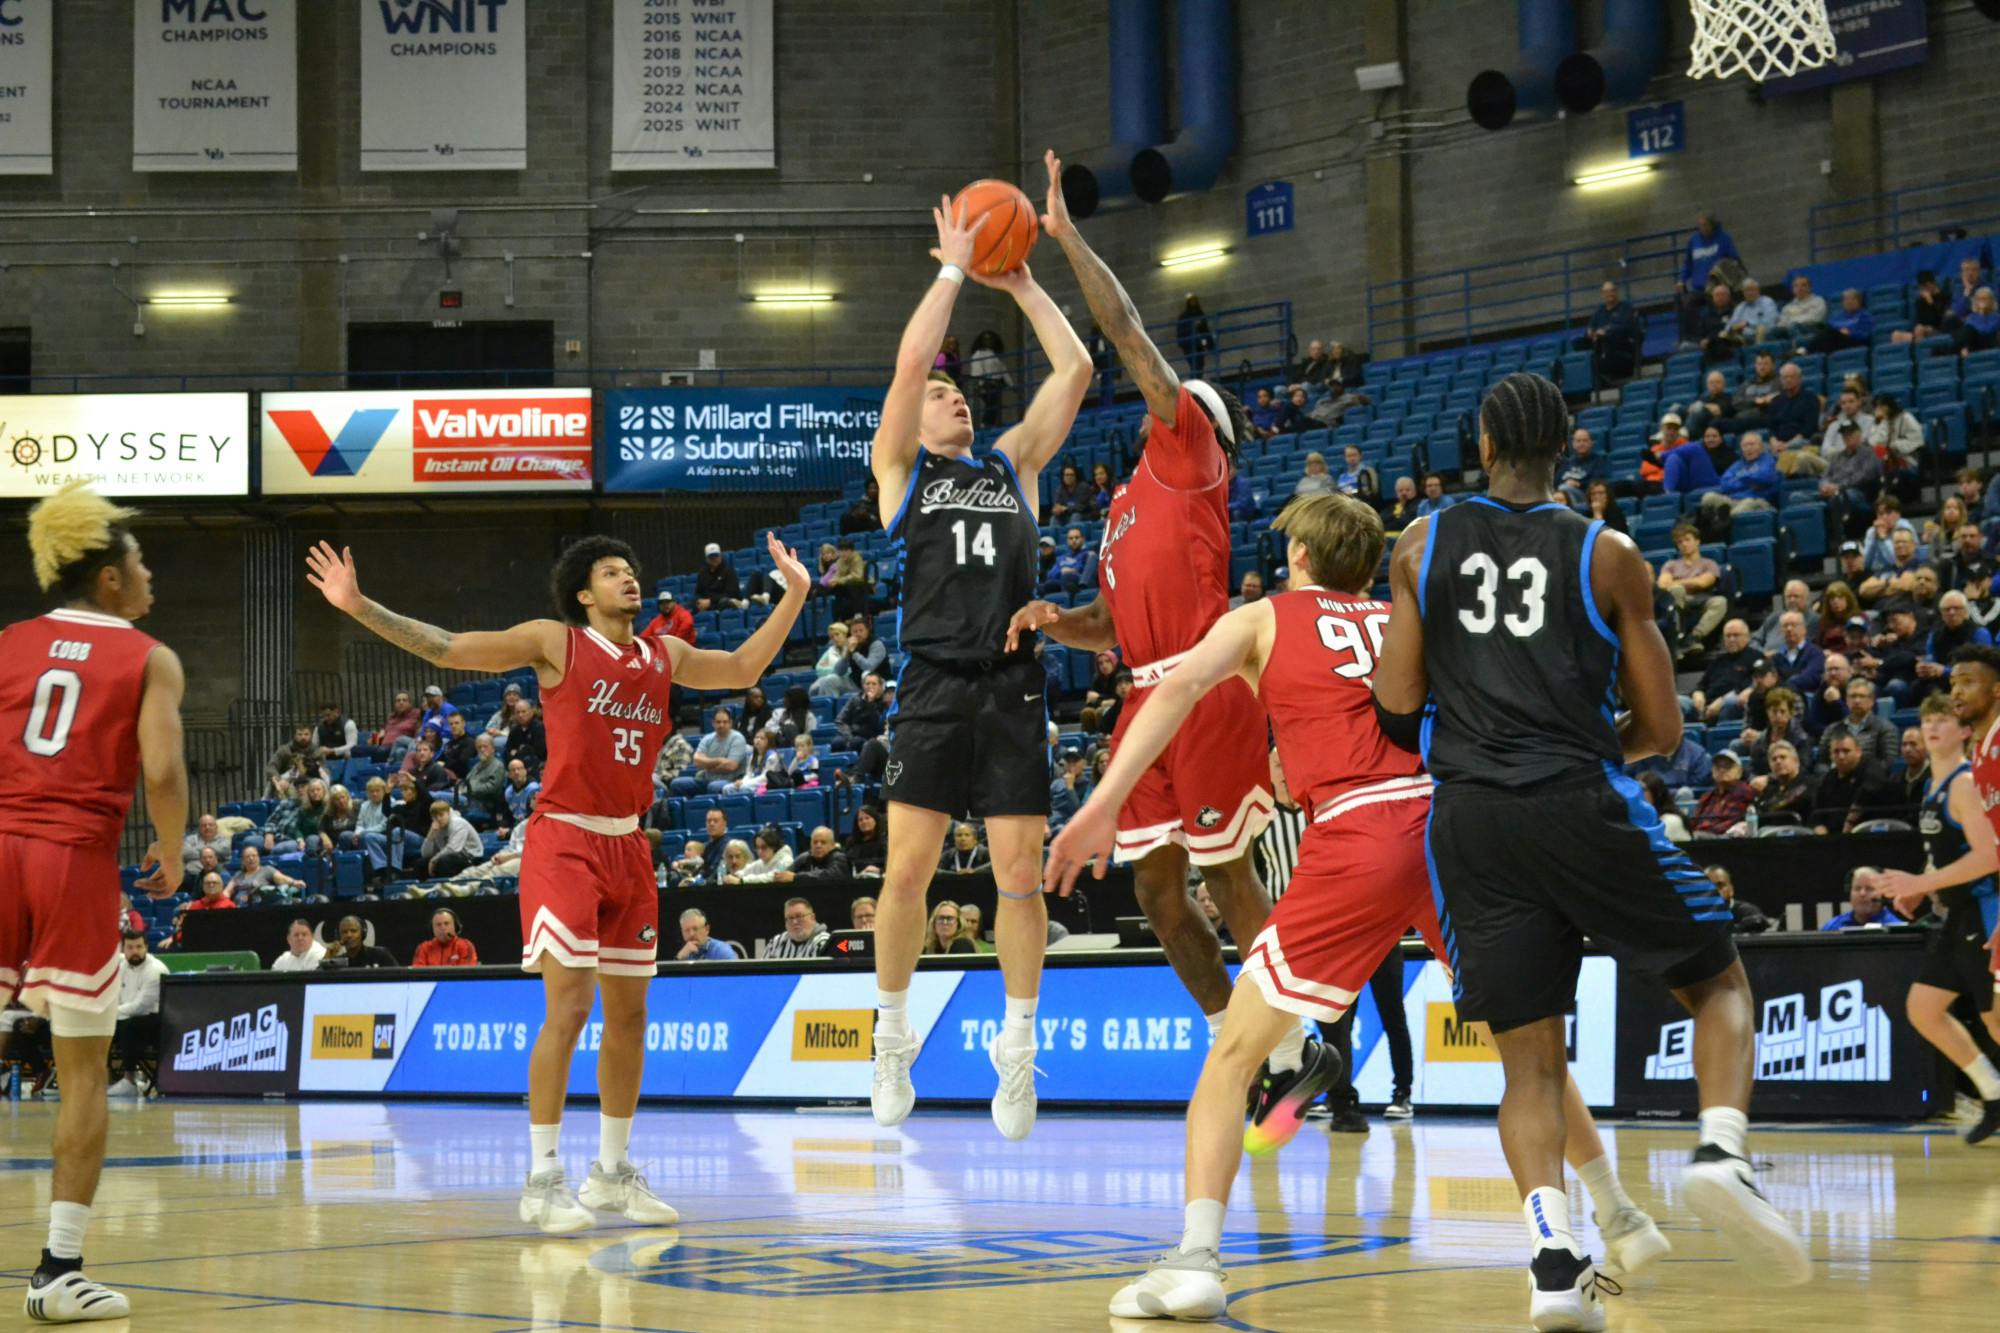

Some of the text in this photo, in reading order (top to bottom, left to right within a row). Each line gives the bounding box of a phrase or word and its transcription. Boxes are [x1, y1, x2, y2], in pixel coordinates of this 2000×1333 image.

[161, 0, 268, 23] MAC
[378, 0, 508, 34] WNIT
[643, 12, 737, 25] 2015 WNIT
[161, 27, 269, 43] CHAMPIONS
[643, 30, 743, 42] 2016 NCAA
[390, 42, 497, 56] CHAMPIONS
[643, 48, 743, 60] 2018 NCAA
[191, 79, 237, 91] NCAA
[643, 66, 743, 78] 2019 NCAA
[158, 96, 270, 109] TOURNAMENT
[643, 84, 743, 96] 2022 NCAA
[643, 102, 741, 114] 2024 WNIT
[643, 119, 741, 132] 2025 WNIT
[1639, 124, 1675, 152] 112
[1256, 205, 1285, 230] 111
[417, 407, 587, 438] Valvoline
[684, 402, 880, 430] Millard Fillmore
[12, 431, 232, 467] ODYSSEY
[684, 433, 804, 461] Suburban
[116, 472, 207, 485] NETWORK
[424, 456, 585, 474] Instant Oil Change
[920, 477, 1019, 514] Buffalo
[951, 519, 997, 566] 14
[1458, 552, 1548, 637] 33
[48, 639, 93, 661] COBB
[21, 667, 83, 758] 0
[587, 679, 662, 725] Huskies
[612, 727, 644, 766] 25
[183, 1009, 272, 1056] ECMC
[321, 1023, 395, 1049] Milton CAT
[433, 1022, 528, 1051] TODAY'S
[646, 1021, 729, 1051] ONSOR
[804, 1022, 859, 1049] Milton
[961, 1018, 1087, 1051] TOY'S
[1102, 1017, 1192, 1051] GAME
[1665, 988, 1853, 1058] EMC
